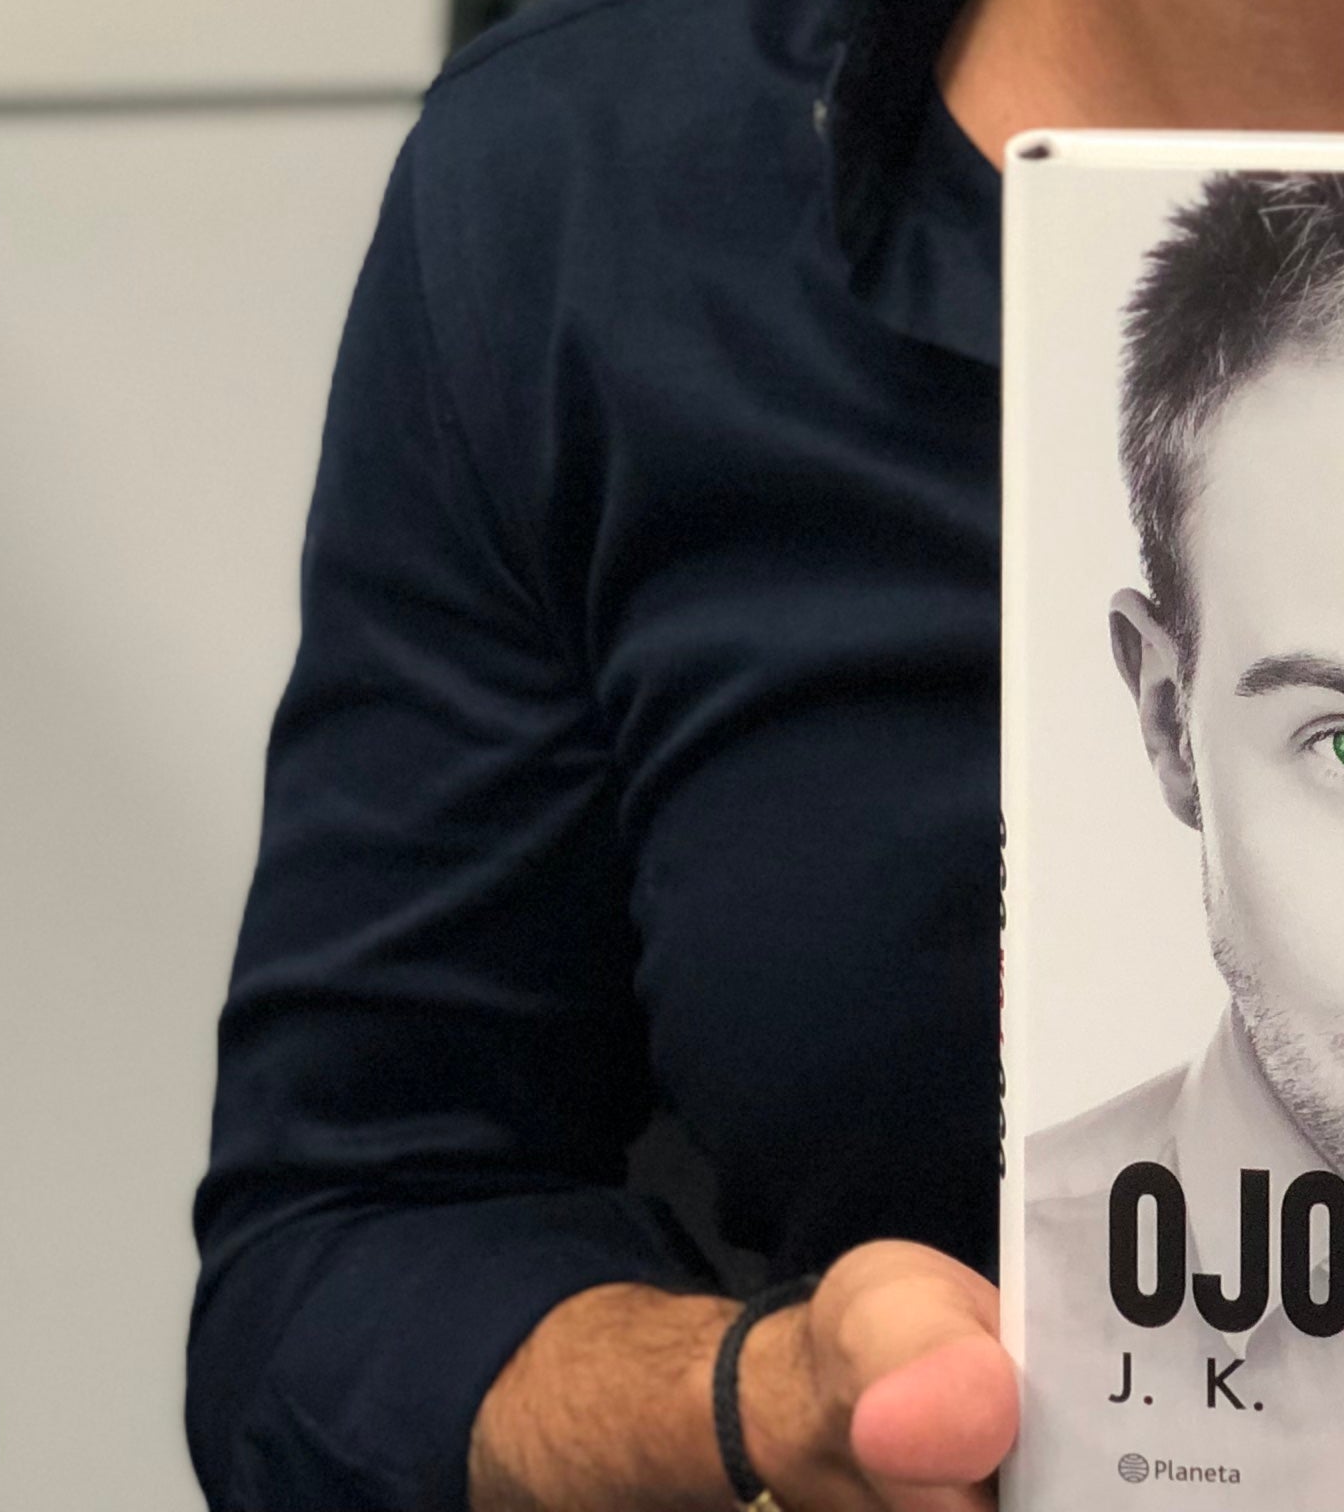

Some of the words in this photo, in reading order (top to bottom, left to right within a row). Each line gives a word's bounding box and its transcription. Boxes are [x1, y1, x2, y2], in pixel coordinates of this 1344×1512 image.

[1108, 1351, 1154, 1405] J.
[1206, 1356, 1265, 1412] K.
[1154, 1459, 1242, 1485] Planeta
